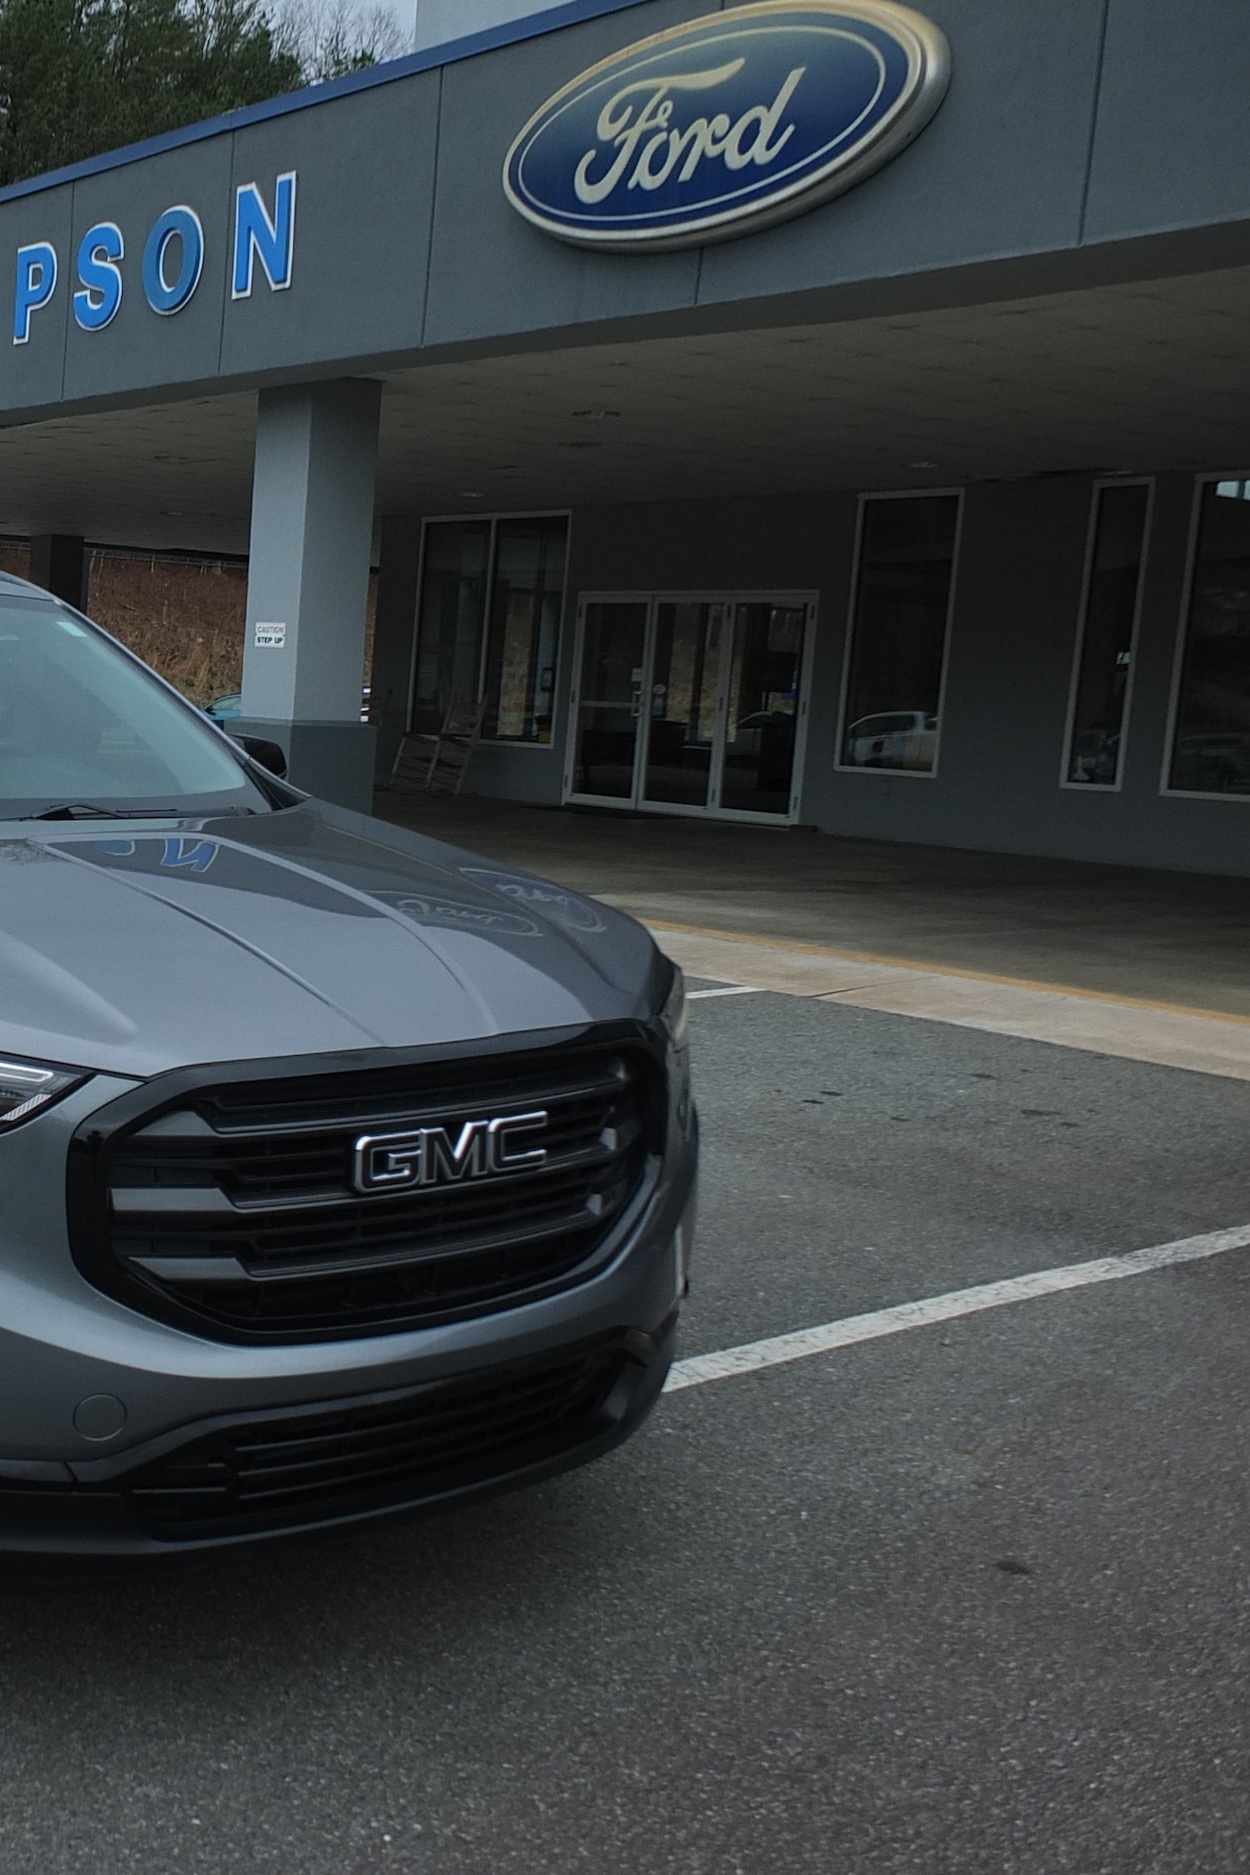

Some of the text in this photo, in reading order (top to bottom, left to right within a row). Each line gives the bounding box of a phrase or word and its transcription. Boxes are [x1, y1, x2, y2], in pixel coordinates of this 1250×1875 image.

[573, 57, 807, 205] Ford
[257, 625, 285, 634] CAUTION
[257, 636, 284, 644] STEP UP
[354, 1110, 548, 1193] GMC
